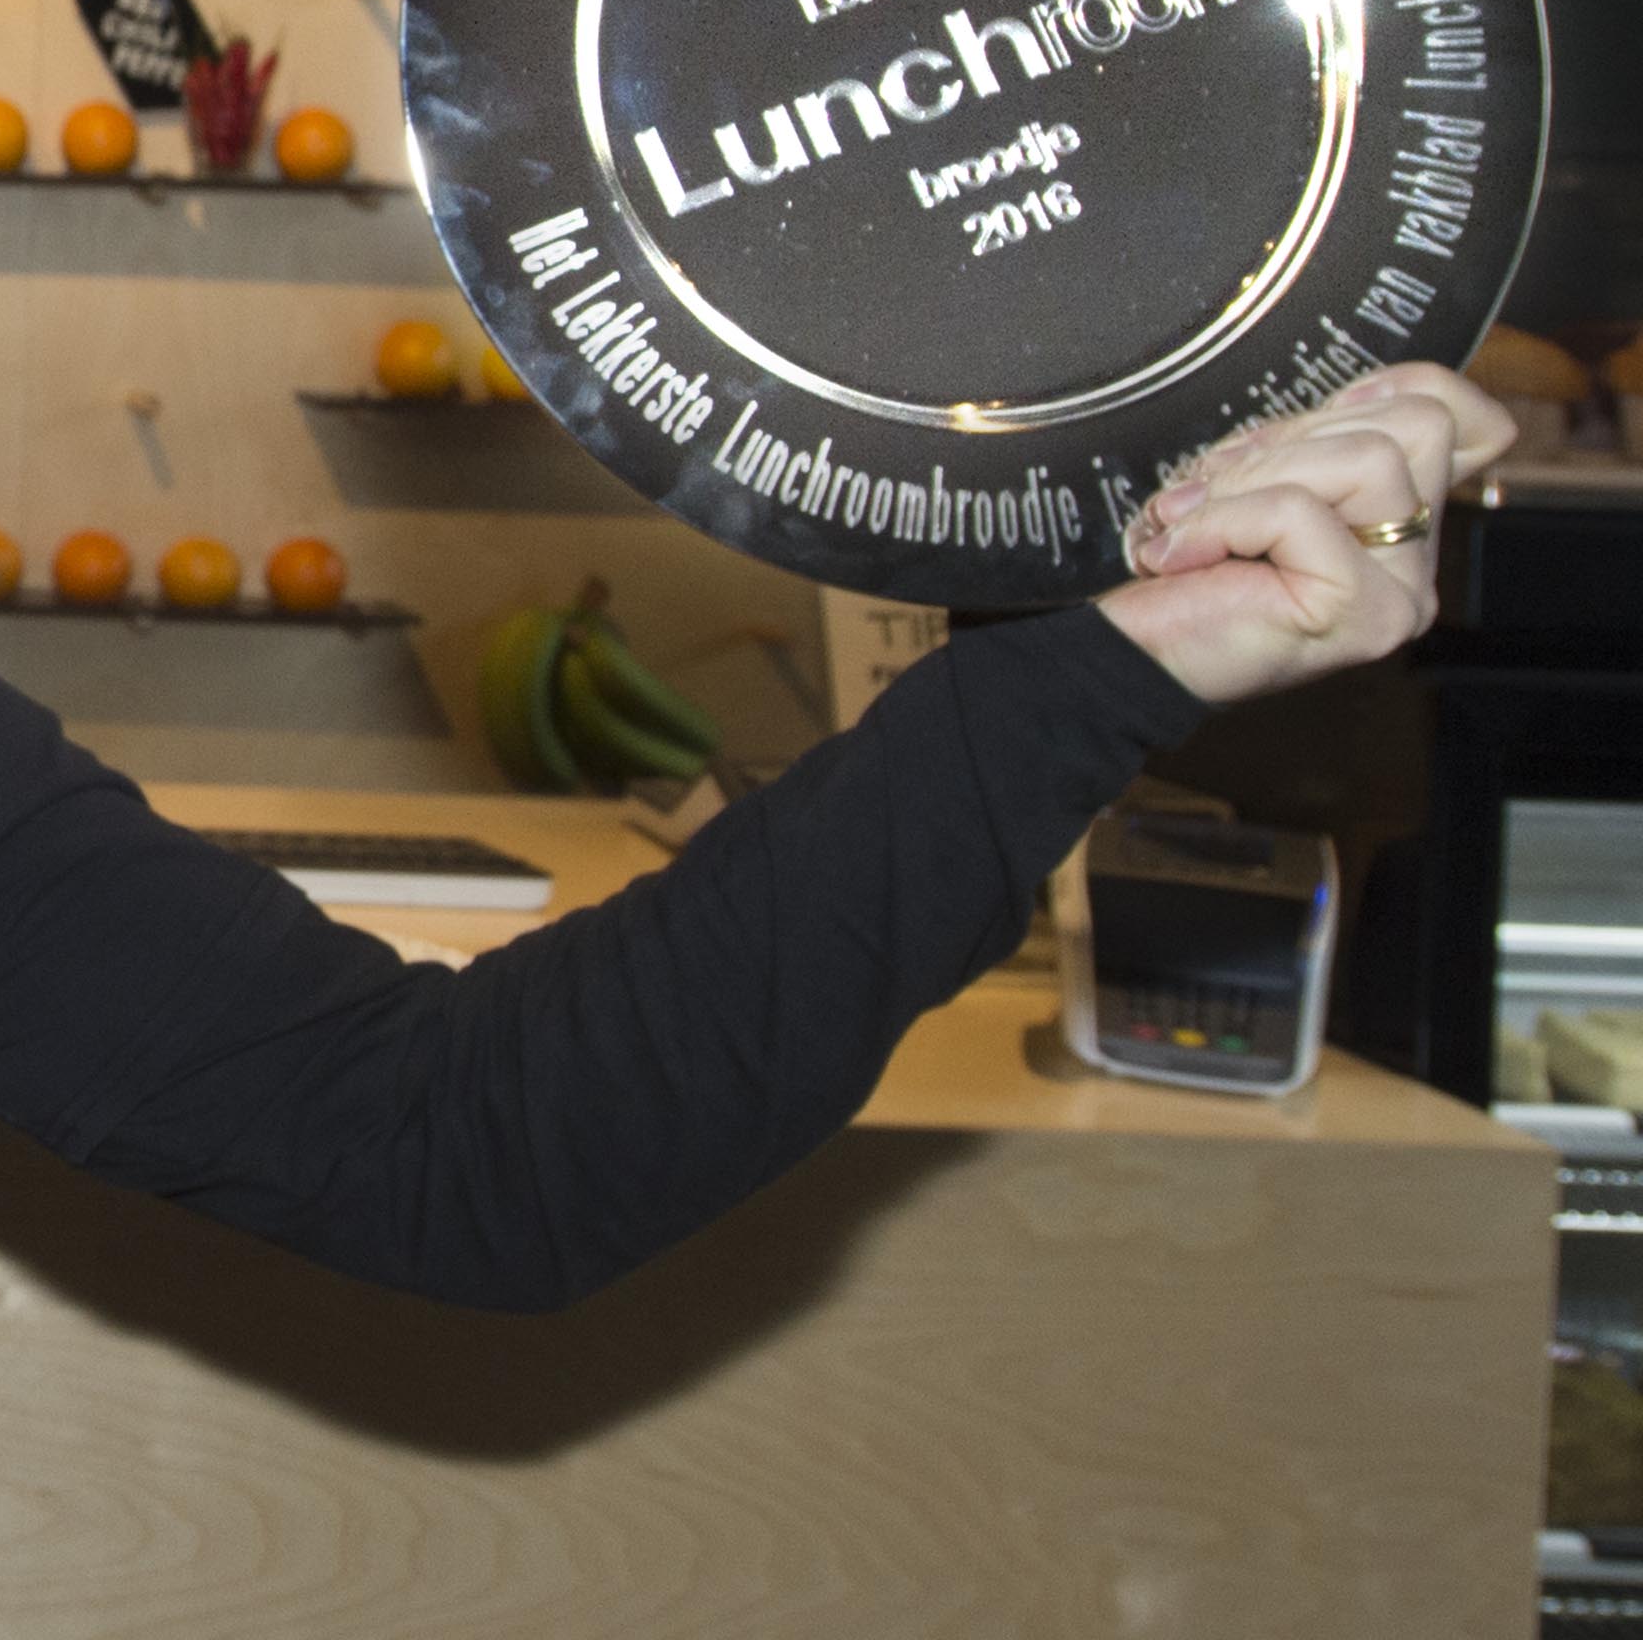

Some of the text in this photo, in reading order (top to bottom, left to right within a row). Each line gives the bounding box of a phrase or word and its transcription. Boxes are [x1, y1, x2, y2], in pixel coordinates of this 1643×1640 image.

[909, 122, 1081, 210] broodje
[1388, 108, 1485, 259] vakblad
[509, 207, 599, 290] Het
[962, 180, 1082, 257] 2016
[1356, 265, 1437, 339] van
[551, 271, 713, 445] Lekkerste
[713, 400, 1082, 567] Lunchroombroodje
